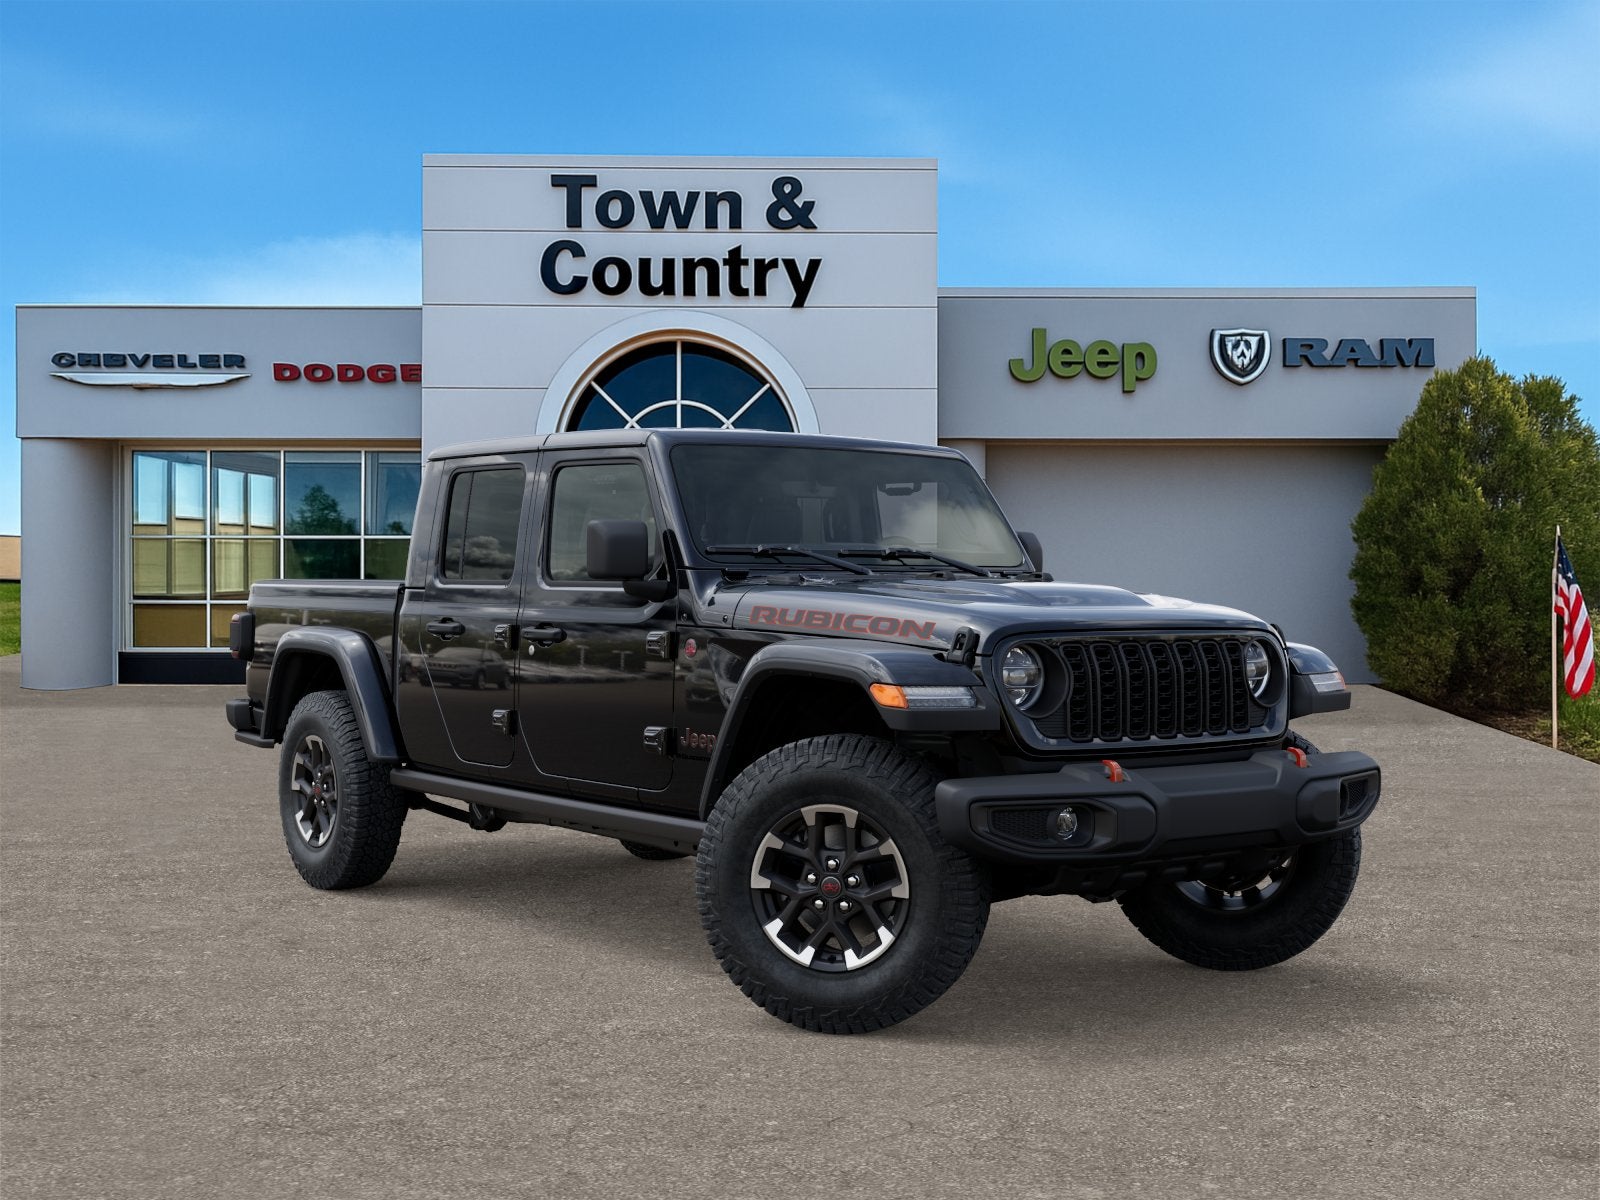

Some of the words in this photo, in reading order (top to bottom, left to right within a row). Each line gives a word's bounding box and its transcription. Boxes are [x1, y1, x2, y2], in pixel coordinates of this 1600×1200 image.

[551, 174, 743, 230] Town
[765, 176, 817, 230] &
[541, 239, 822, 308] Country
[1009, 328, 1157, 393] Jeep
[1283, 337, 1435, 368] RAM
[273, 362, 422, 383] DODGE
[750, 606, 936, 641] RUBICON
[680, 727, 717, 753] Jeep
